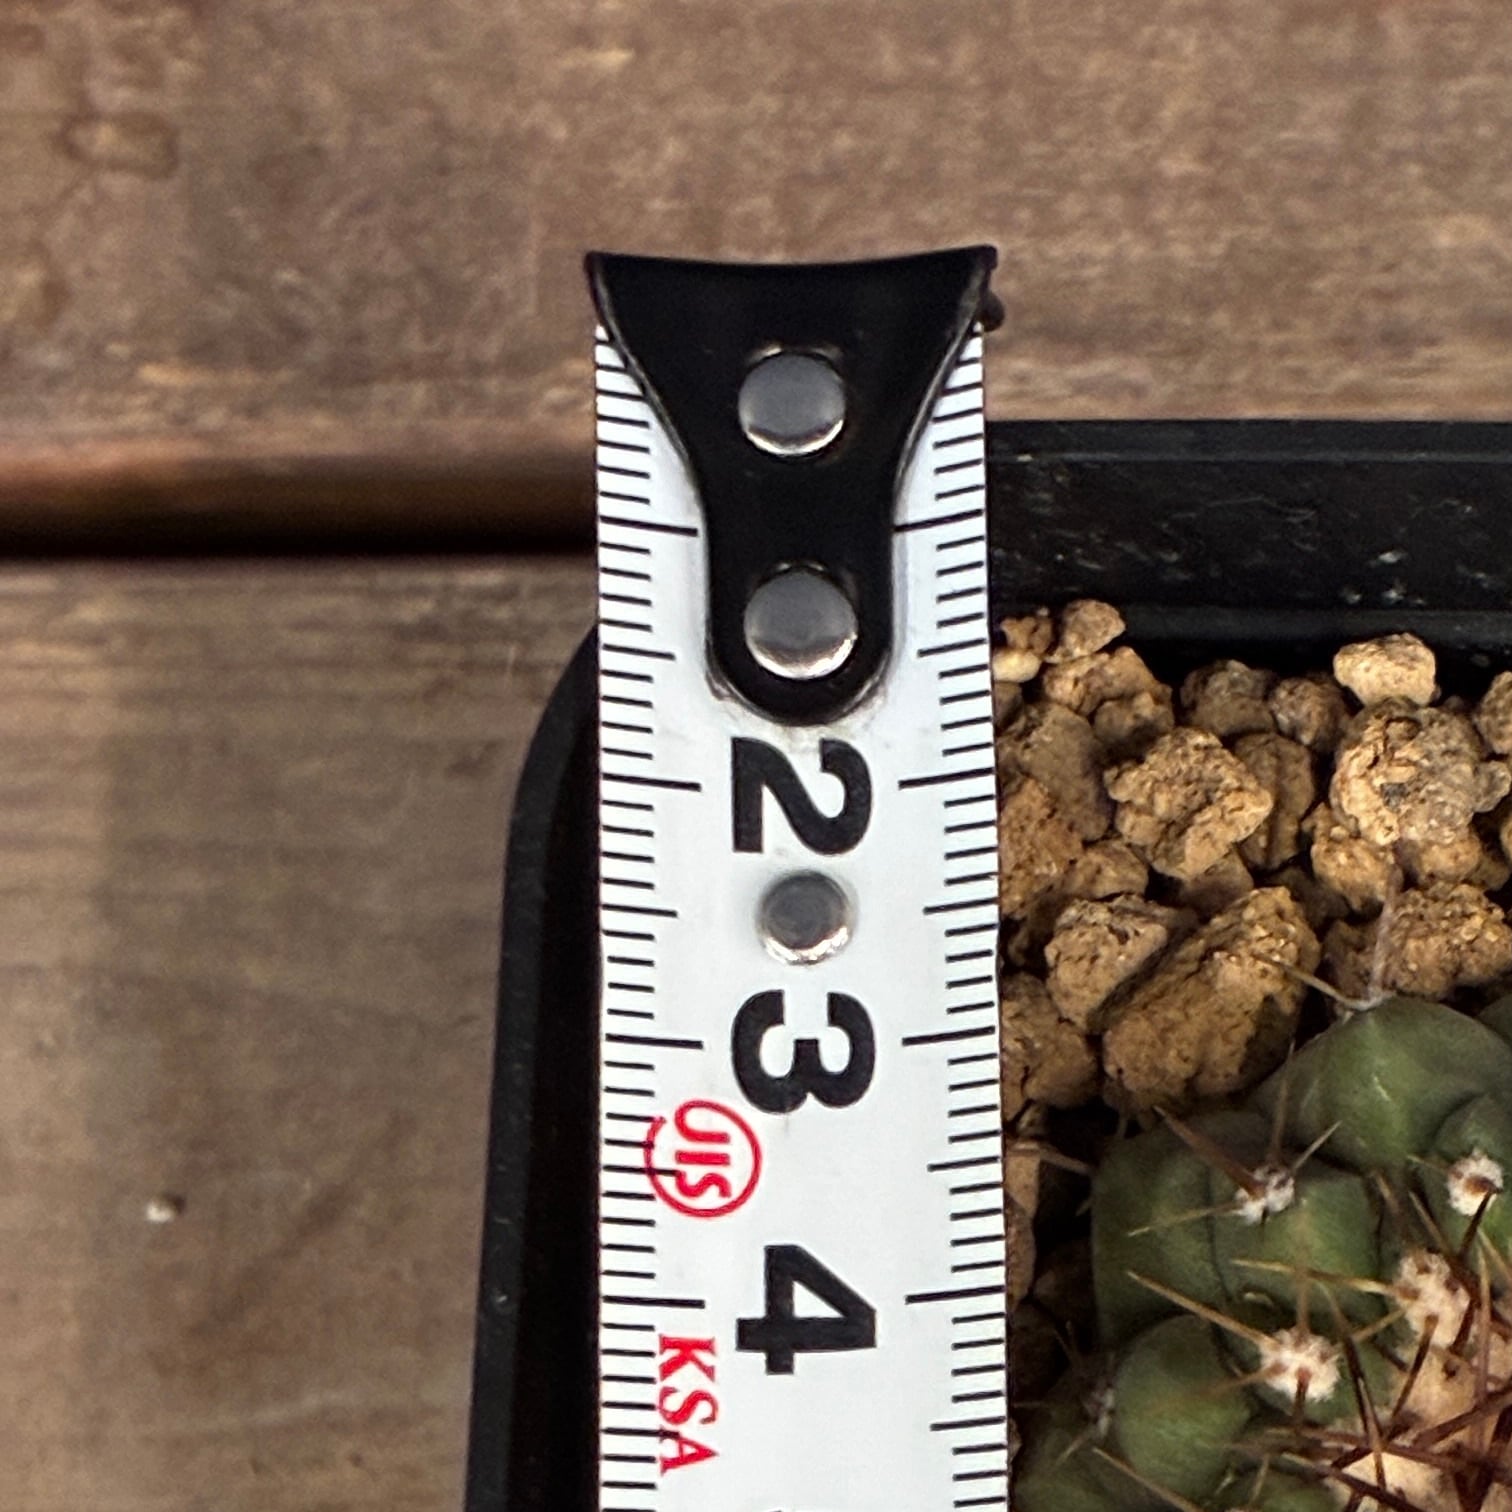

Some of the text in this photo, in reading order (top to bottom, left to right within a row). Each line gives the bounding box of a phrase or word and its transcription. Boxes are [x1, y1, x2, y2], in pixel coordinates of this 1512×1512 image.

[731, 736, 873, 854] 2
[731, 989, 875, 1114] 3
[672, 1099, 732, 1199] JIS
[735, 1244, 877, 1376] 4
[656, 1333, 720, 1477] KSA
